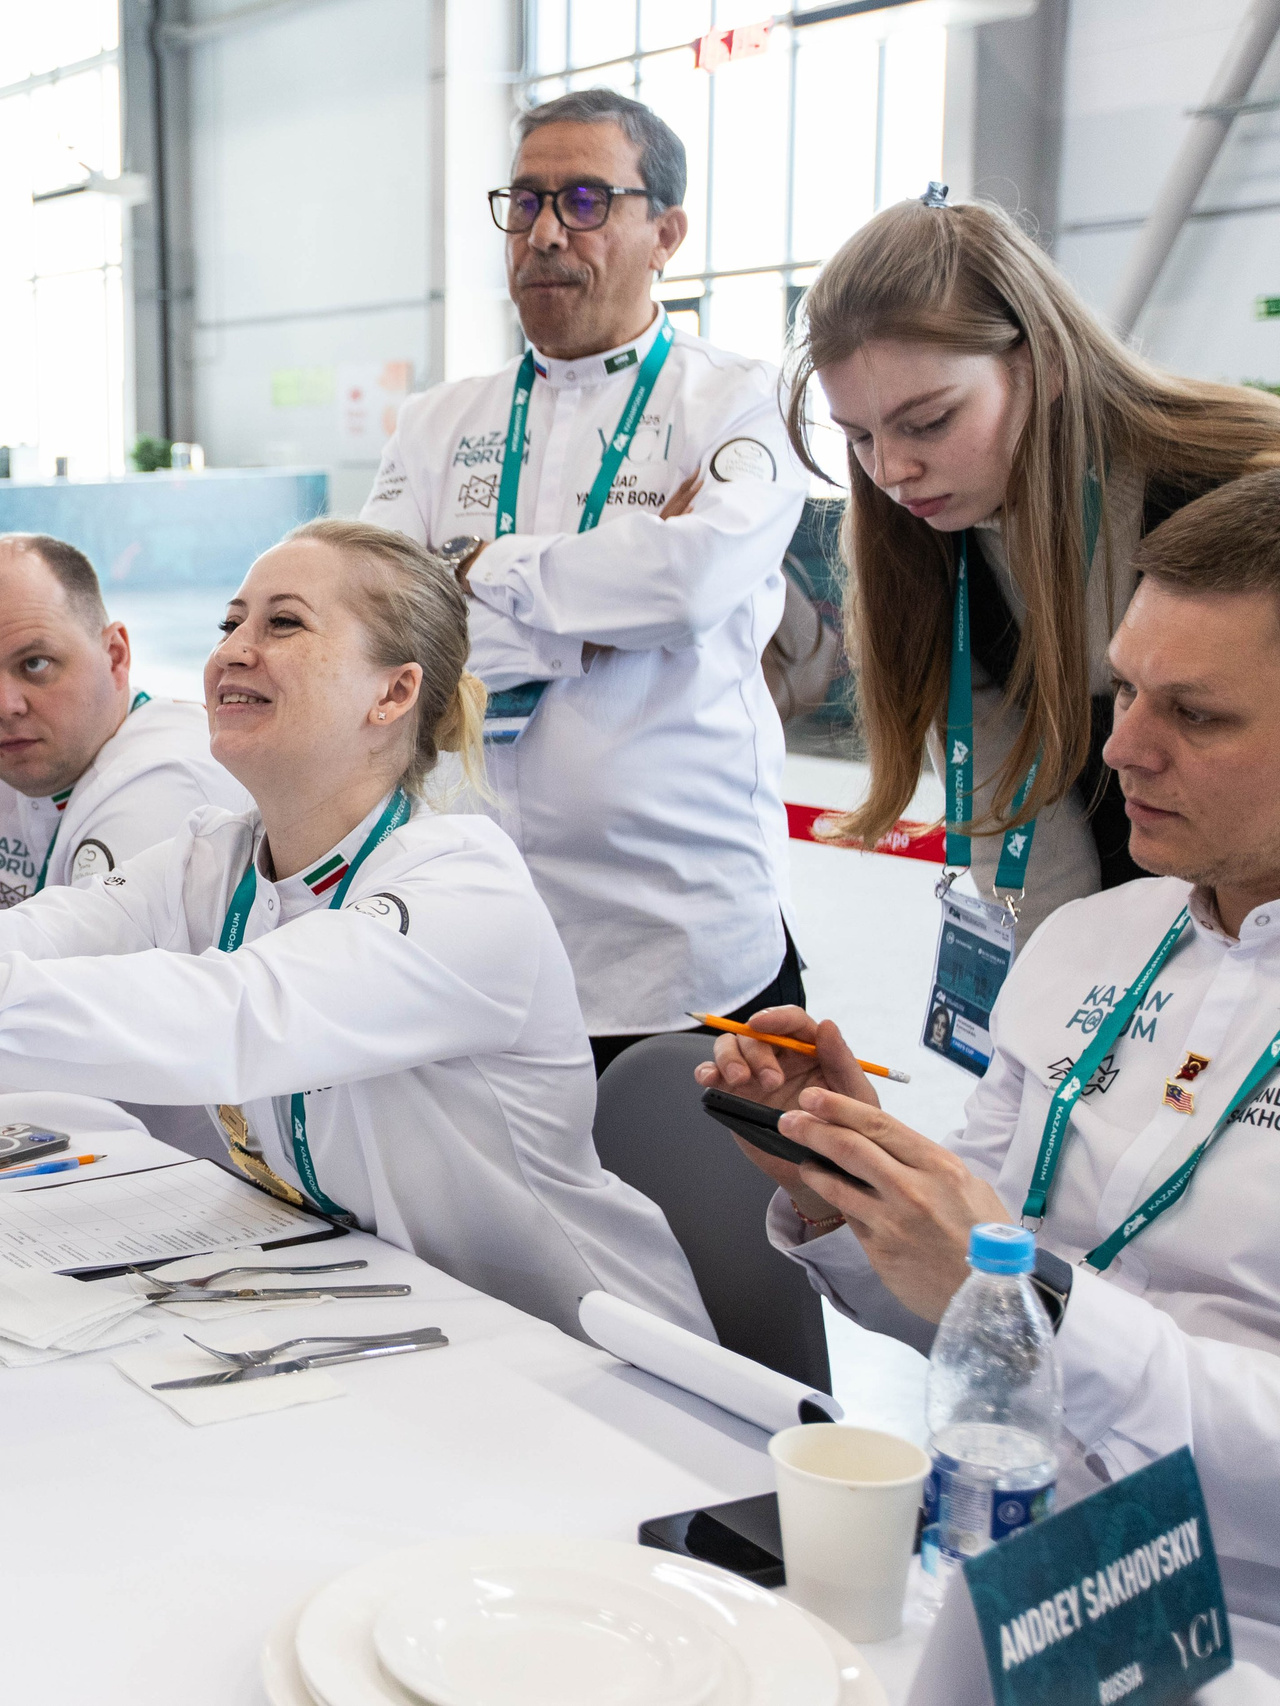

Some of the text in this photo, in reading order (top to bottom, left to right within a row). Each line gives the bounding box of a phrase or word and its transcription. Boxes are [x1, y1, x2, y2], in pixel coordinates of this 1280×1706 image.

[1132, 933, 1176, 996] KAZANFORUM
[1039, 1104, 1064, 1182] KAZANFORUM
[1000, 1516, 1201, 1670] ANDREY SAKHOVSKIY
[1098, 1661, 1145, 1705] RUSSIA
